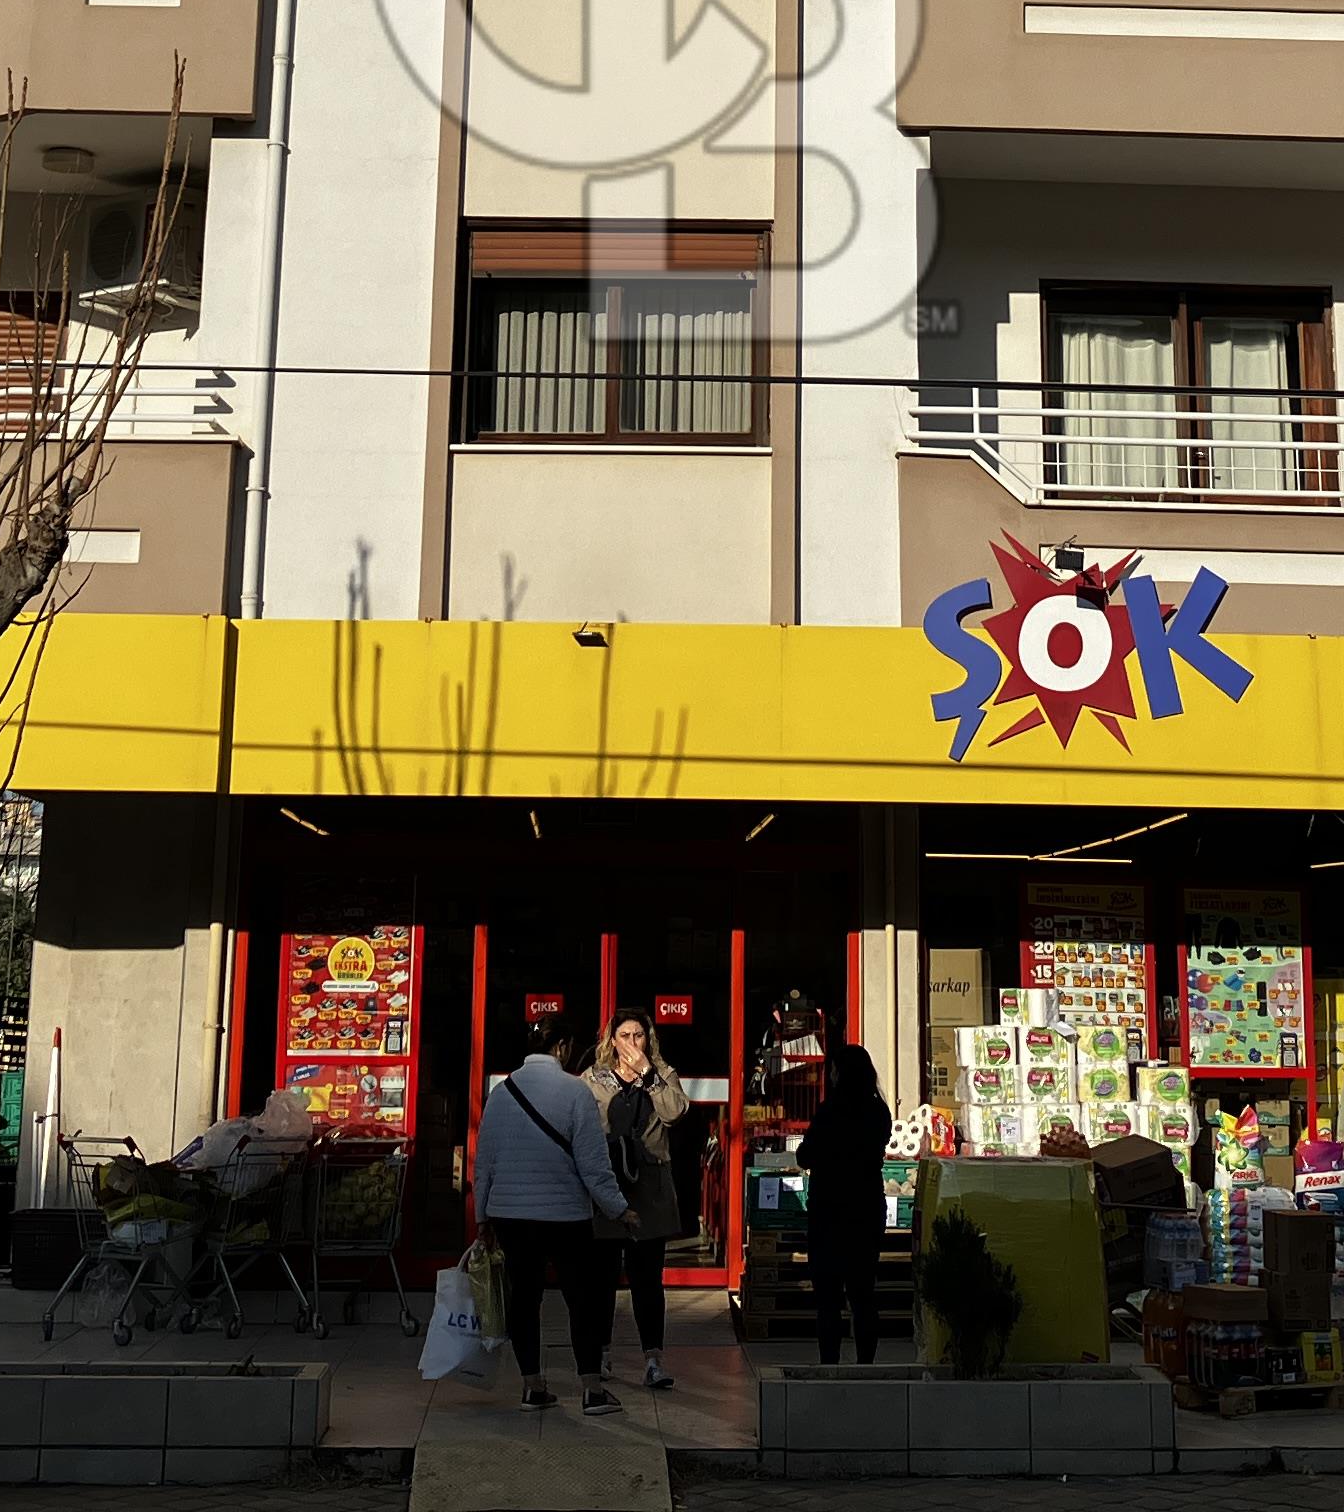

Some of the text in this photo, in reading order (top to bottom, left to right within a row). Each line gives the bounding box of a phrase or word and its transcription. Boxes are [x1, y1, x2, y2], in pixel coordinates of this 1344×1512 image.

[923, 566, 1254, 763] ŞOK
[334, 961, 368, 971] EKSTRA
[659, 1003, 688, 1017] ÇIKIŞ
[1231, 1170, 1259, 1180] ARIEL
[1305, 1175, 1341, 1187] Renax
[448, 1312, 468, 1328] LC
